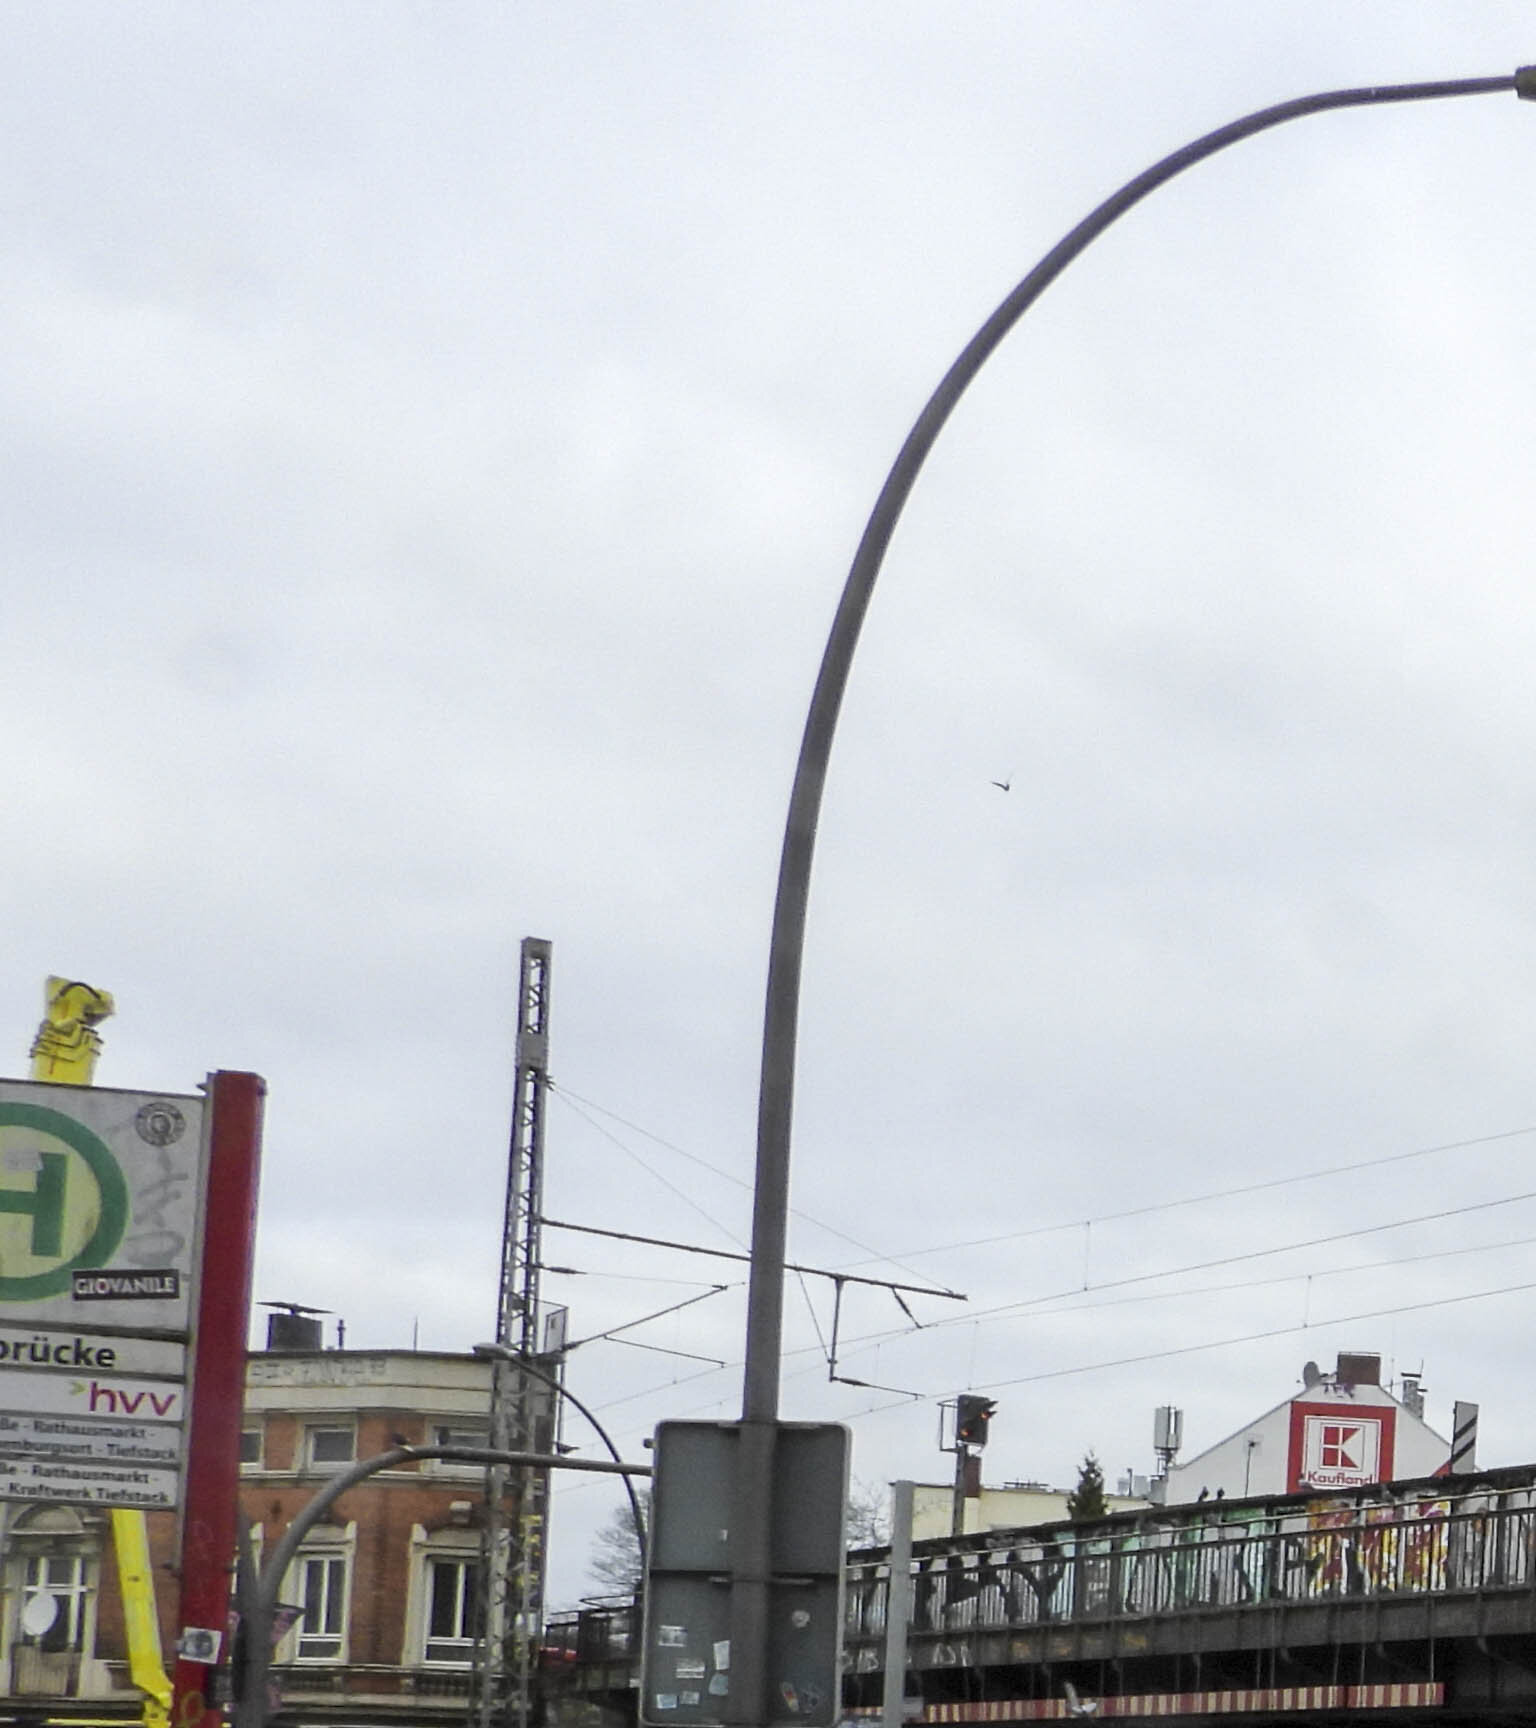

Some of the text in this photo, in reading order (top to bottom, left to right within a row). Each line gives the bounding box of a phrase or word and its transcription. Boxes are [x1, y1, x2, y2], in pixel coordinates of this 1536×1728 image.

[75, 1275, 176, 1295] GIOVANILE
[88, 1381, 177, 1416] hvv
[34, 1420, 146, 1439] Rathausmarkt
[32, 1464, 149, 1484] Rathausmarkt
[1308, 1471, 1373, 1485] Kaufland
